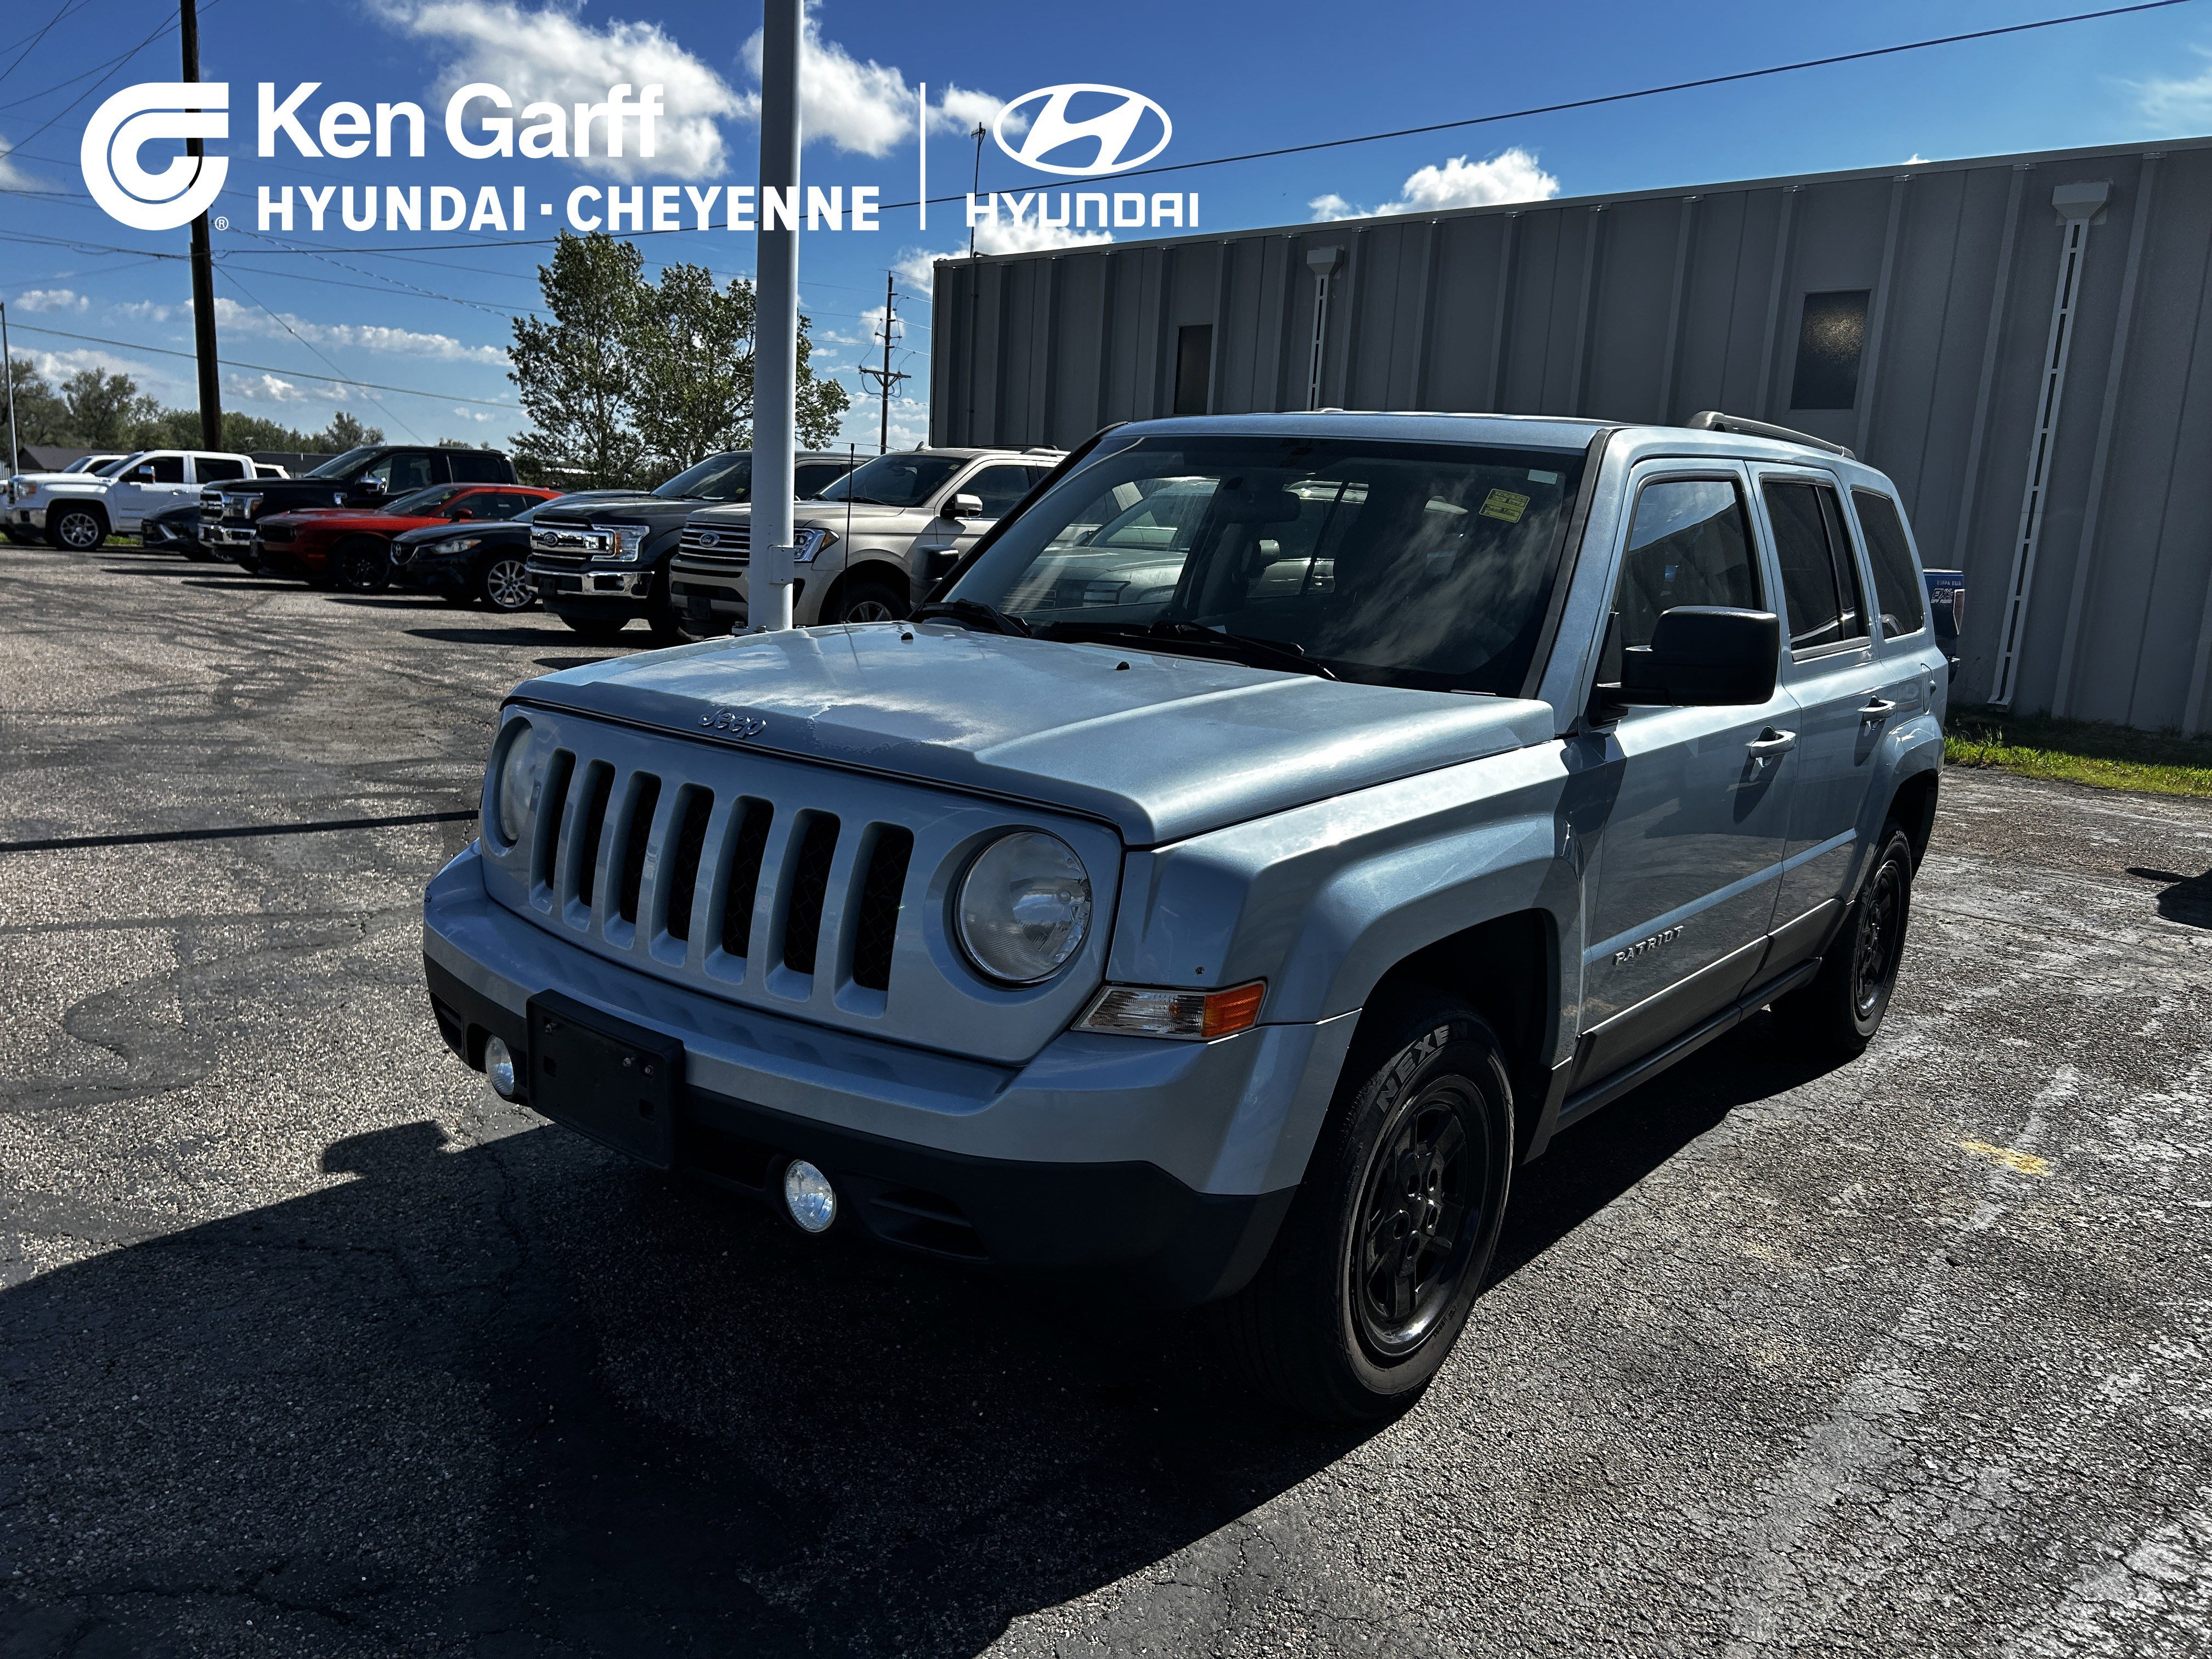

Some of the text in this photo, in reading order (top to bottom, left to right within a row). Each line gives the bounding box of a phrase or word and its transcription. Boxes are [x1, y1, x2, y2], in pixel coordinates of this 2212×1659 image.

[698, 707, 767, 739] Jeep
[1612, 925, 1684, 966] PATRIOT
[1376, 1021, 1469, 1114] NEXEN
